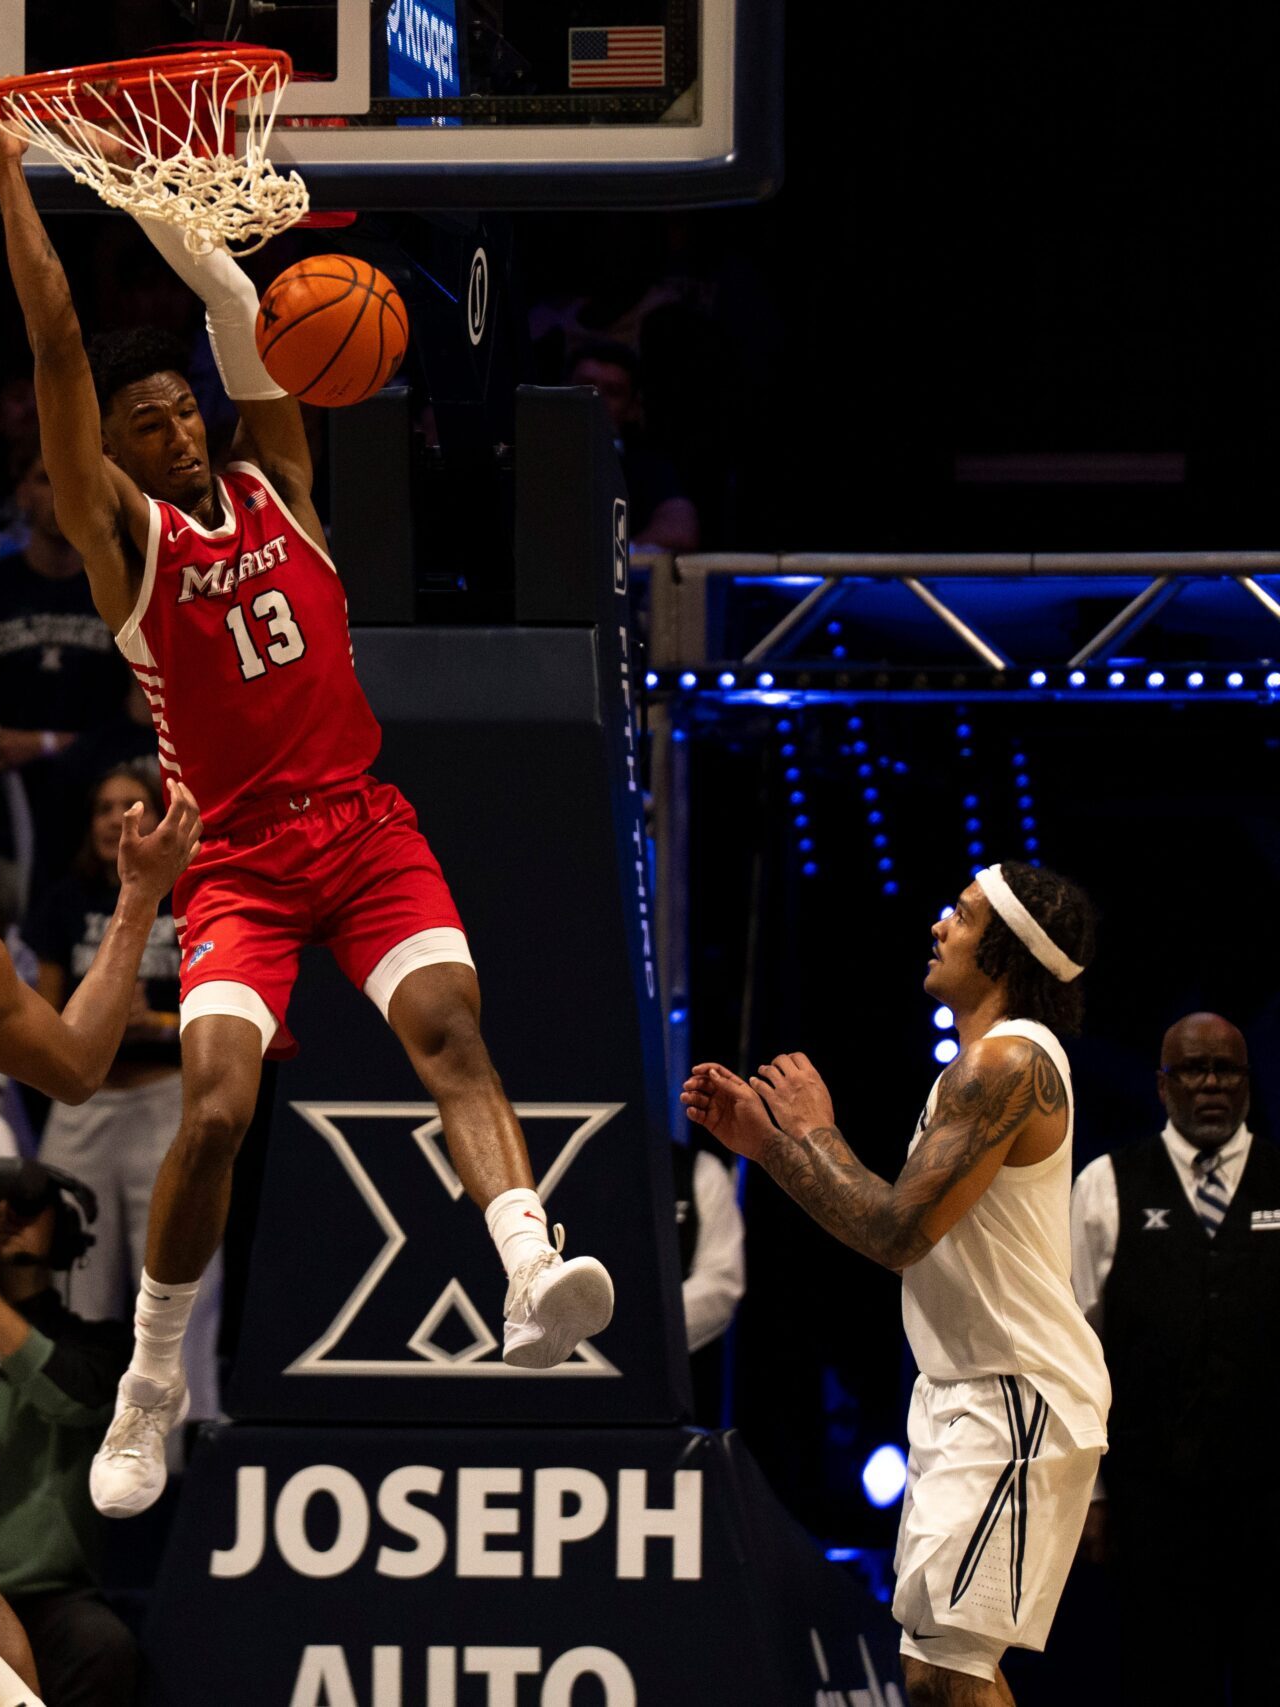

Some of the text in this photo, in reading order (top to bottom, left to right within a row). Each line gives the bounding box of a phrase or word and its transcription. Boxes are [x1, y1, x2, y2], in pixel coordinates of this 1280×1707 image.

[177, 535, 289, 602] MARIST
[224, 587, 308, 683] 13
[618, 625, 656, 1000] FIFTH THIRD
[209, 1464, 704, 1581] JOSEPH
